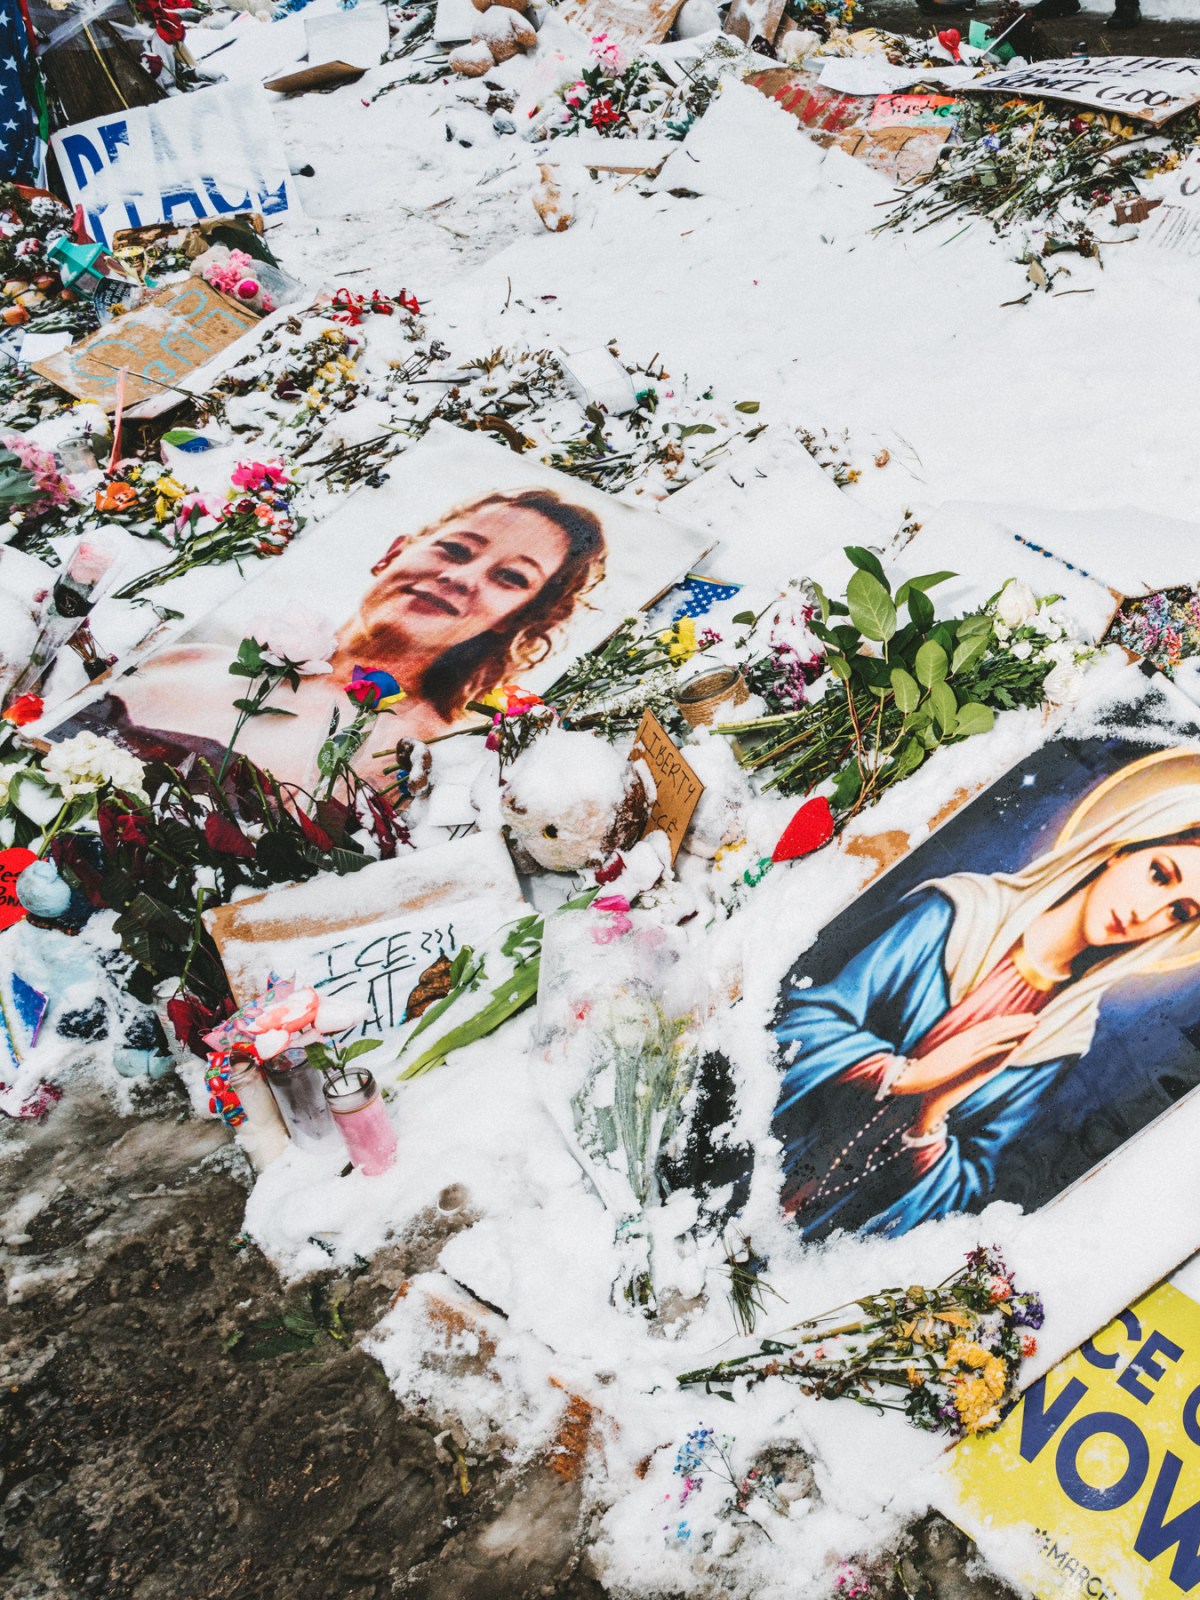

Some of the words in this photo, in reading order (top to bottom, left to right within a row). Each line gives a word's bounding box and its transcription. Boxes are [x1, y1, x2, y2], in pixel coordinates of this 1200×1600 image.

[1096, 86, 1180, 106] GOO
[639, 720, 697, 804] LIBERTY
[1079, 1307, 1185, 1406] CE
